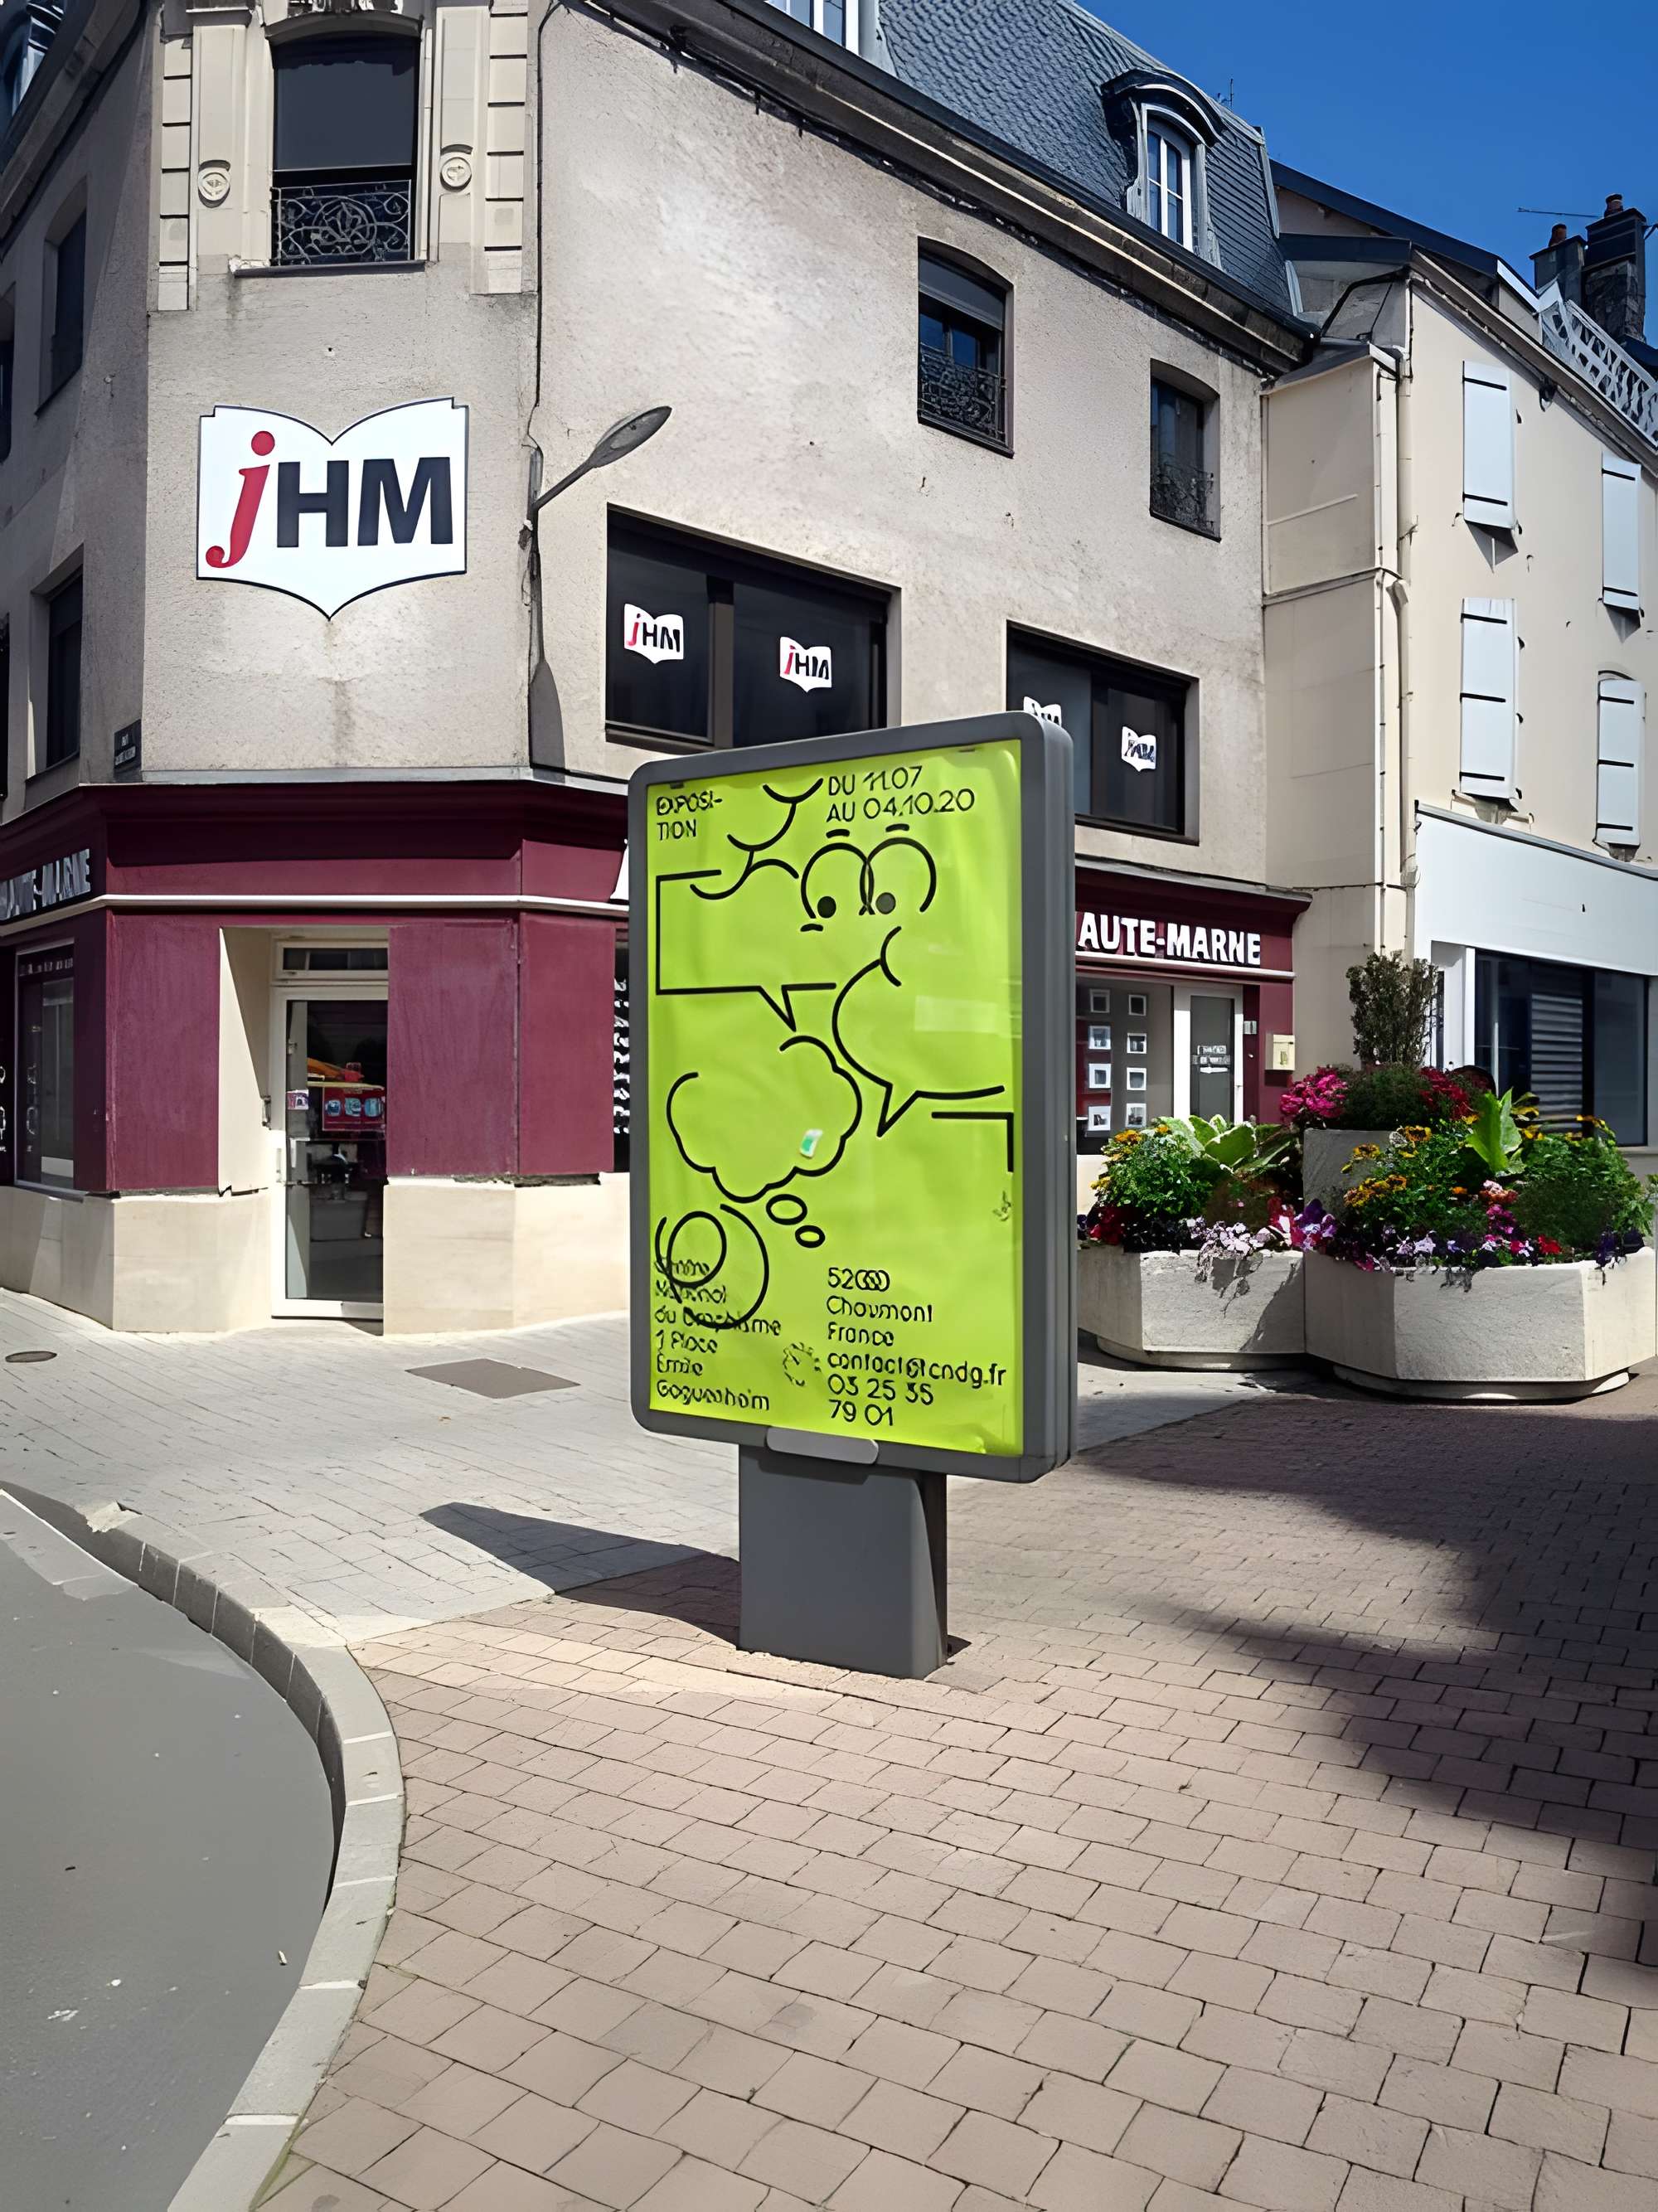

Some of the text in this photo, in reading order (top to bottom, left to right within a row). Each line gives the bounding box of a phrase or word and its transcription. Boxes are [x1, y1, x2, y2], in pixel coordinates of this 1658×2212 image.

[829, 774, 855, 796] DU
[827, 788, 975, 822] AU 04.10.20
[657, 819, 696, 841] TION
[828, 1322, 894, 1346] France
[867, 1378, 895, 1400] 25
[829, 1399, 893, 1426] 79 01
